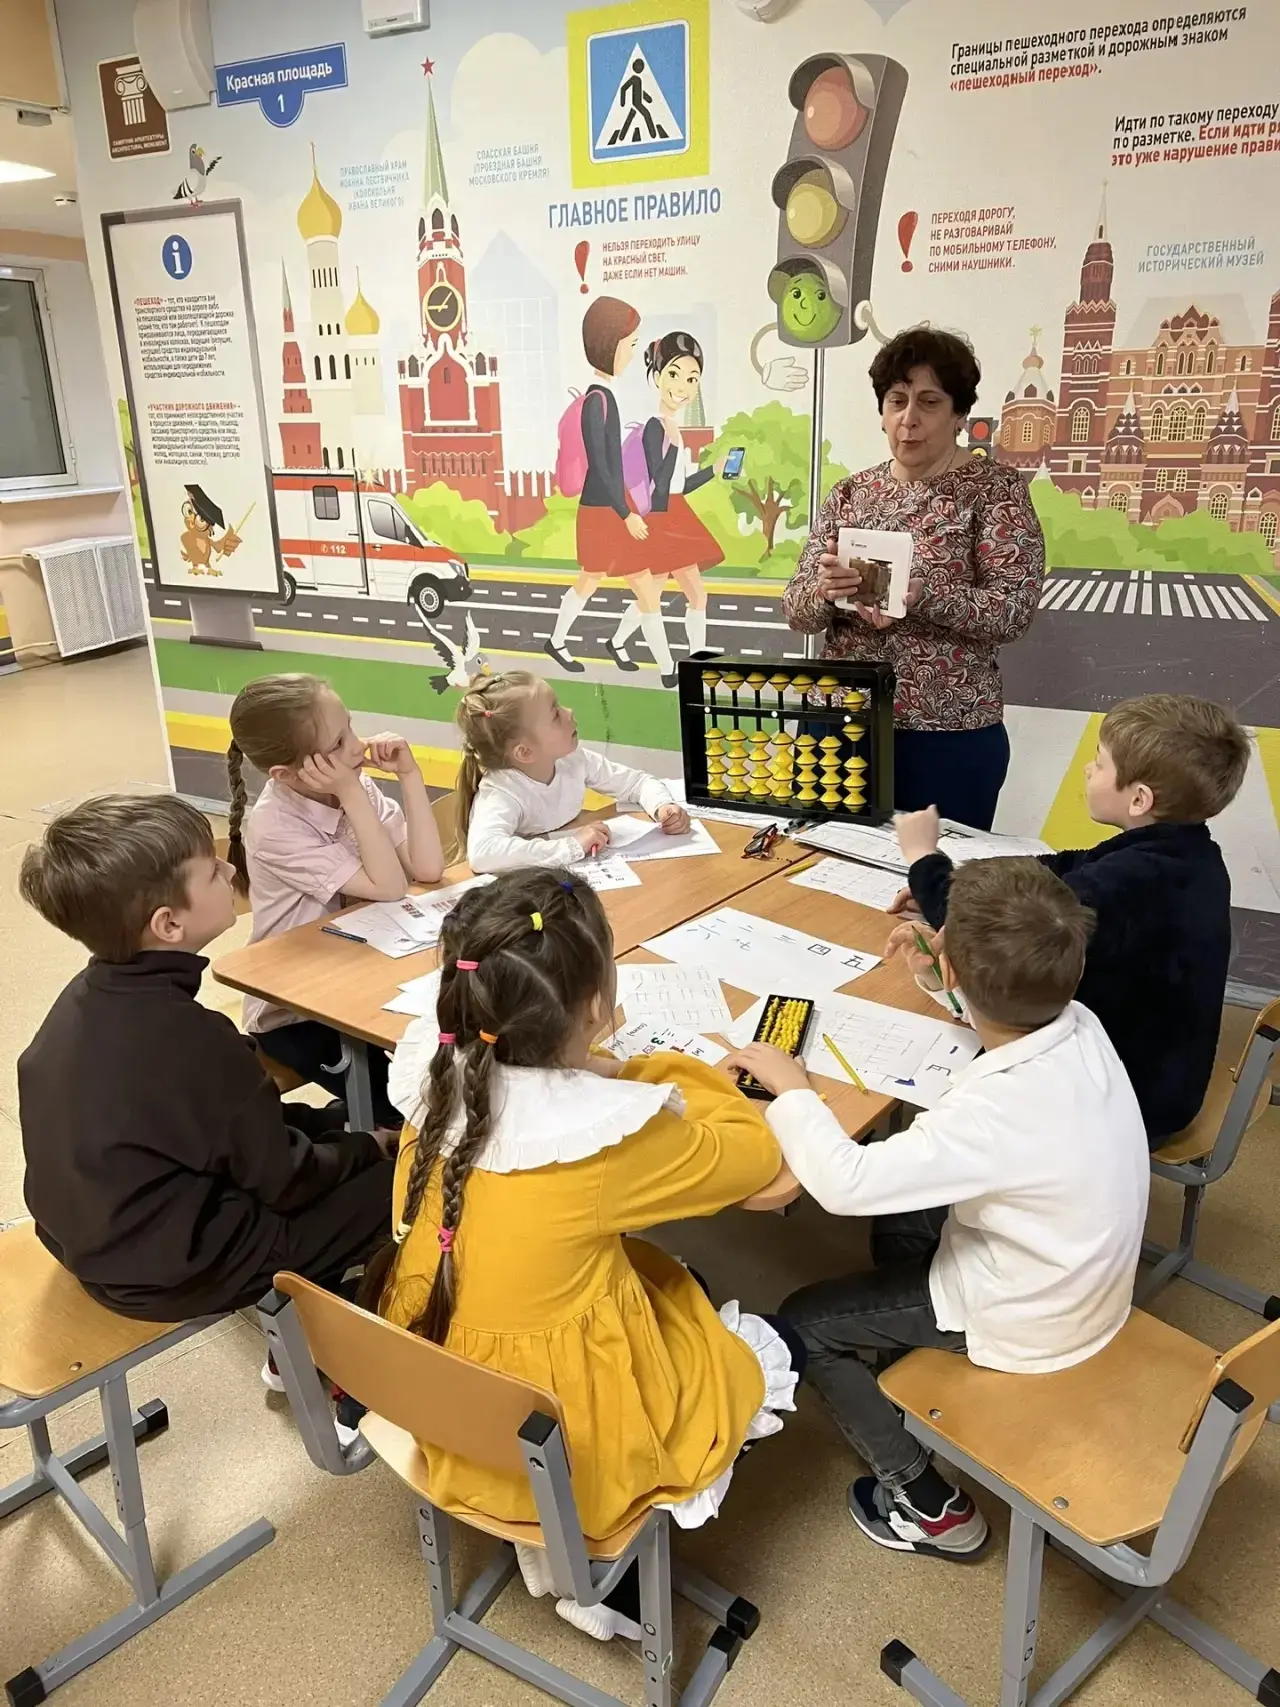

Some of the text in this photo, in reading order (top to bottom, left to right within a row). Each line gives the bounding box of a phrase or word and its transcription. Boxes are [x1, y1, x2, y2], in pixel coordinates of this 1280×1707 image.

[951, 7, 1246, 60] Границы пешеходного перехода определяются
[950, 28, 1228, 76] специальной разметкой и дорожным знаком
[226, 62, 332, 92] Красная площадь
[950, 63, 1102, 92] «пешеходный переход».
[278, 94, 284, 112] 1
[1115, 104, 1279, 134] Идти по такому переходу
[1114, 134, 1129, 150] по
[1132, 127, 1194, 152] разметке.
[1199, 125, 1230, 140] Если
[1233, 122, 1265, 138] идти
[476, 144, 538, 160] СПАССКАЯ БАШНЯ
[1112, 151, 1132, 166] это
[1134, 147, 1160, 168] уже
[1163, 142, 1237, 166] нарушение
[340, 160, 406, 175] ПРАВОСЛАВНЫЙ ХРАМ
[516, 156, 541, 168] БАШНЯ
[365, 171, 409, 184] ЛЕСТВИЧНИКА
[469, 172, 516, 187] МОСКОВСКОГО
[549, 188, 720, 228] ГЛАВНОЕ ПРАВИЛО
[931, 206, 1015, 224] ПЕРЕХОДЯ ДОРОГУ,
[930, 222, 1012, 240] НЕ РАЗГОВАРИВАЙ
[602, 235, 700, 252] НЕЛЬЗЯ ПЕРЕХОДИТЬ УЛИЦУ
[930, 236, 1056, 256] ПО МОБИЛЬНОМУ ТЕЛЕФОНУ,
[1146, 236, 1254, 256] ГОСУДАРСТВЕННЫЙ
[602, 252, 666, 266] НА КРАСНЫЙ СВЕТ,
[928, 258, 1015, 272] СНИМИ НАУШНИКИ.
[1138, 251, 1264, 272] ИСТОРИЧЕСКИЙ МУЗЕЙ
[603, 266, 688, 282] ДАЖЕ ЕСЛИ НЕТ МАШИН.
[330, 544, 346, 554] 112
[807, 943, 831, 956] 四
[840, 955, 866, 971] 五
[651, 1037, 665, 1045] 3
